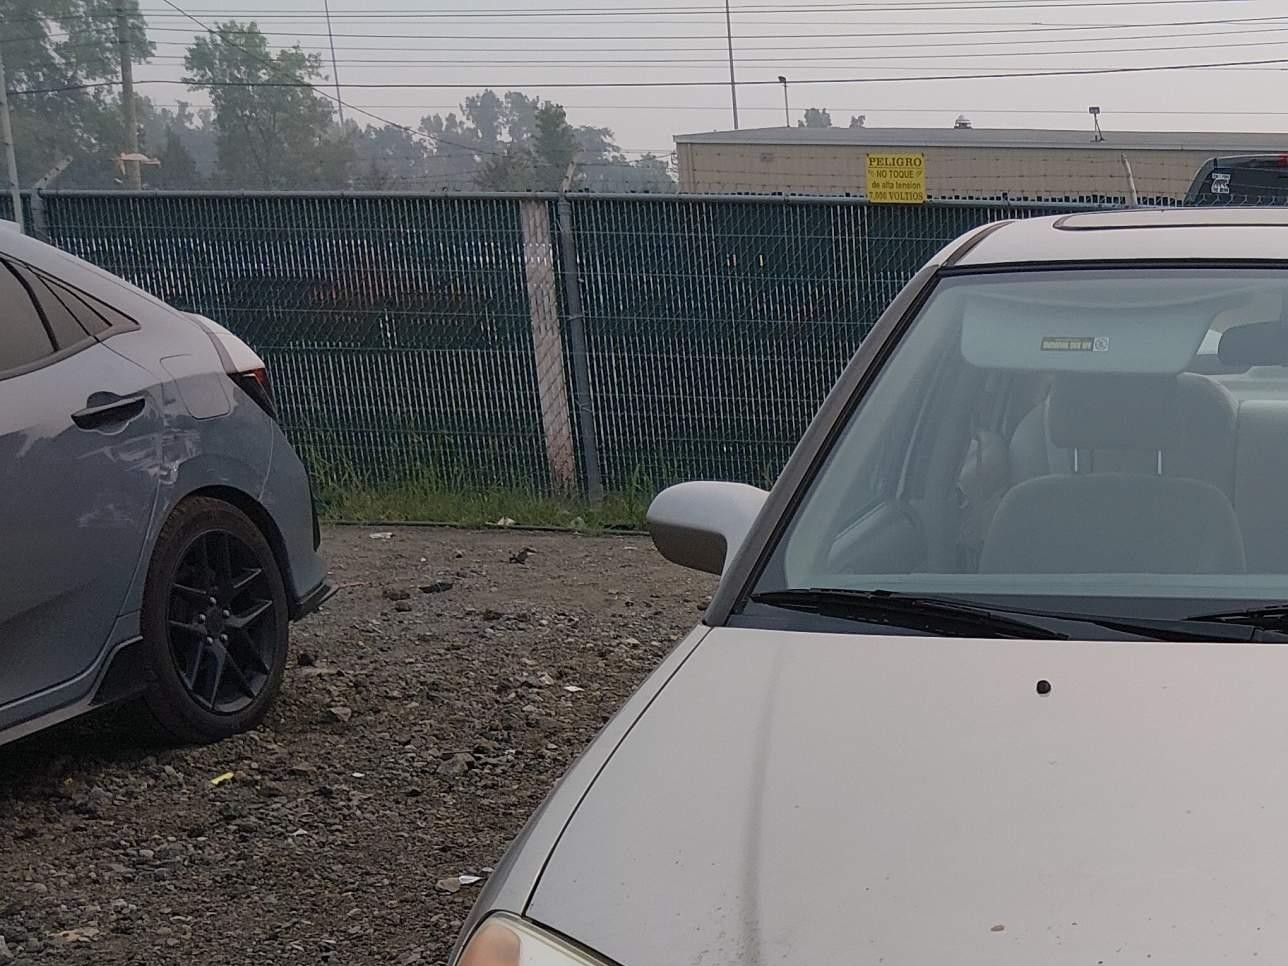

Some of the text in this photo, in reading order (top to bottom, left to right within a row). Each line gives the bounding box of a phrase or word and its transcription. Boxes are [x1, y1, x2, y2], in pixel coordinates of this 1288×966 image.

[868, 157, 922, 167] PELIGRO
[876, 169, 914, 178] NO TOQUE
[888, 191, 923, 201] VOLTIOS
